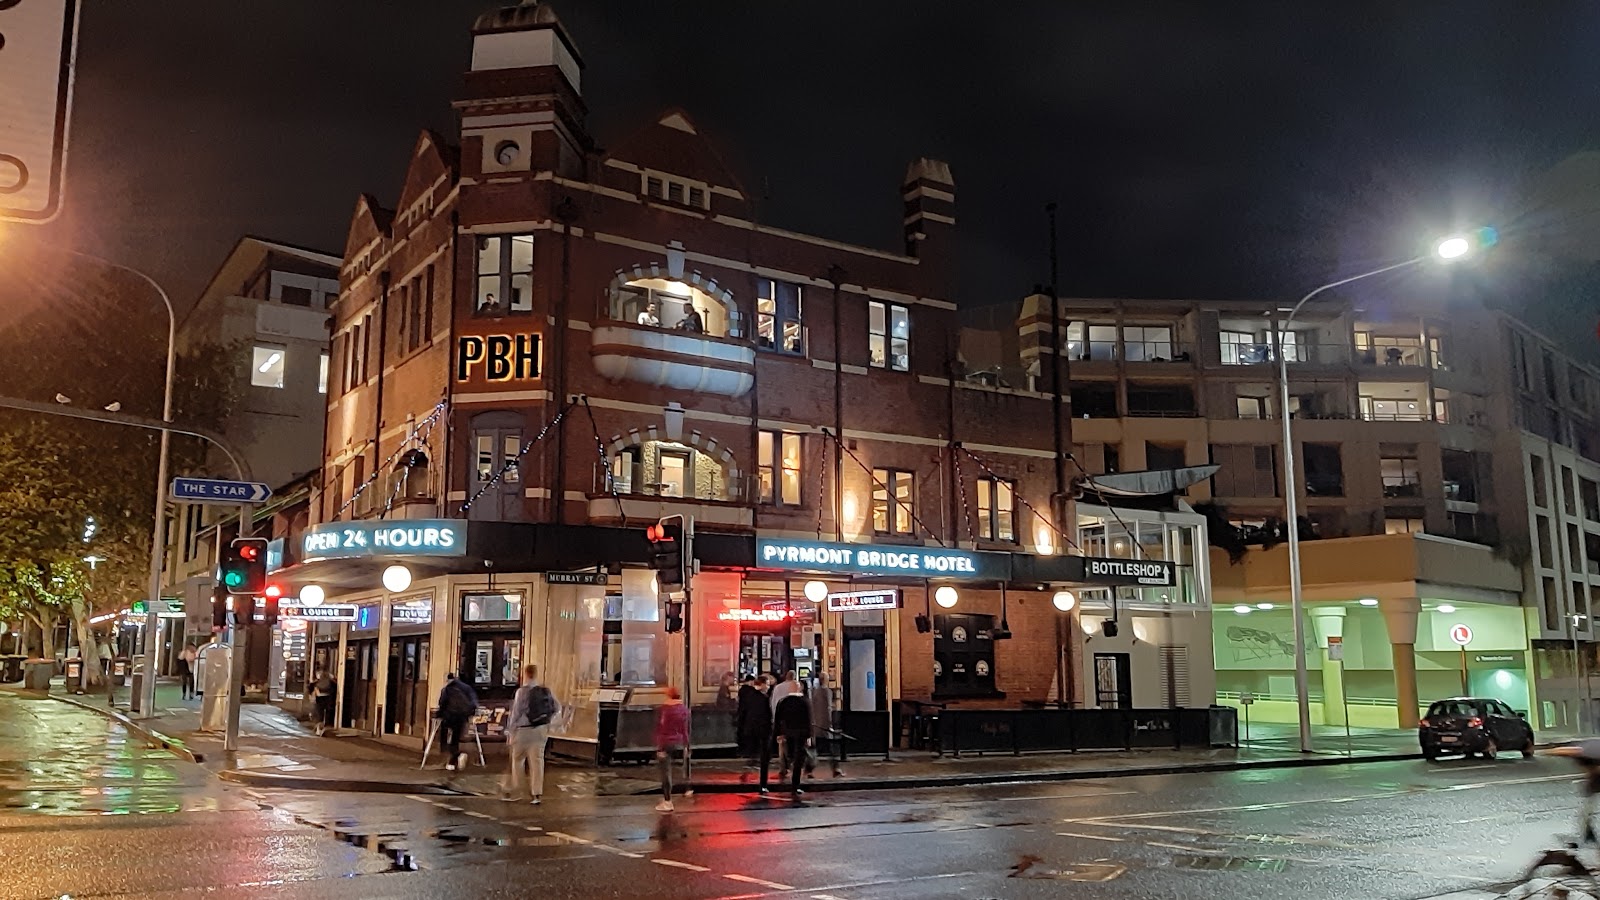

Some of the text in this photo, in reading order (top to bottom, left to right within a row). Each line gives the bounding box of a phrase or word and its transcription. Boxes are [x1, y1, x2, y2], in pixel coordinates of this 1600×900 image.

[458, 332, 543, 382] PBH
[183, 483, 246, 496] THE STAR
[305, 528, 455, 552] OPEN 24 HOURS
[763, 545, 976, 572] PYRMONT BRIDGE HOTEL
[1092, 561, 1162, 577] BOTTLESHOP
[549, 574, 594, 583] MURRAY ST
[860, 595, 885, 605] LOUNGE
[302, 608, 340, 616] LOUNGE
